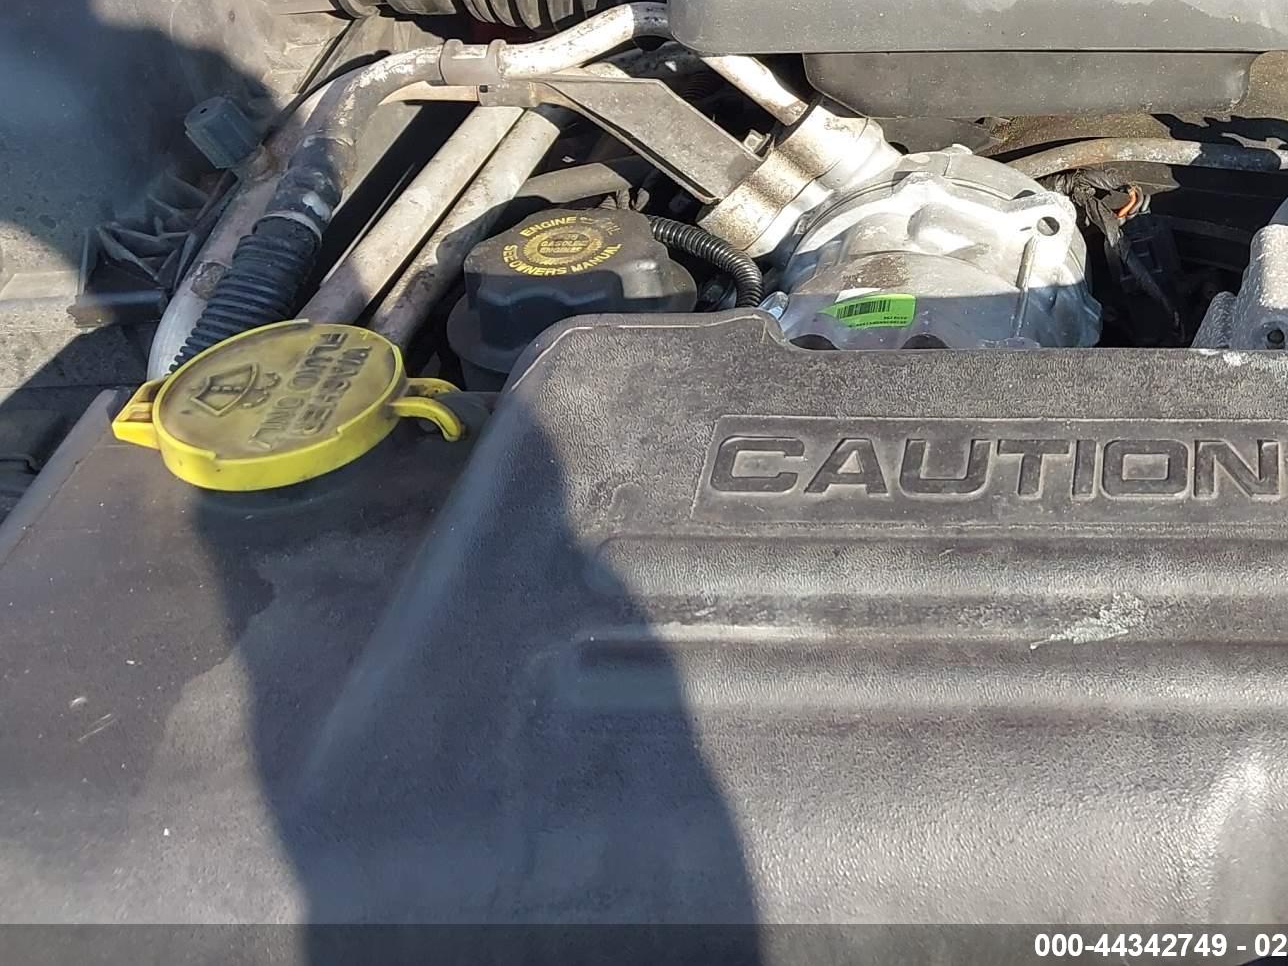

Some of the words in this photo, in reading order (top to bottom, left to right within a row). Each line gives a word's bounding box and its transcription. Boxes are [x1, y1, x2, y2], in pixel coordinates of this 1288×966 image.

[519, 216, 577, 237] ENGINE
[509, 258, 568, 276] OWNERS
[570, 243, 623, 273] MANUAL
[287, 345, 372, 436] WASHER
[709, 436, 1284, 500] CAUTION
